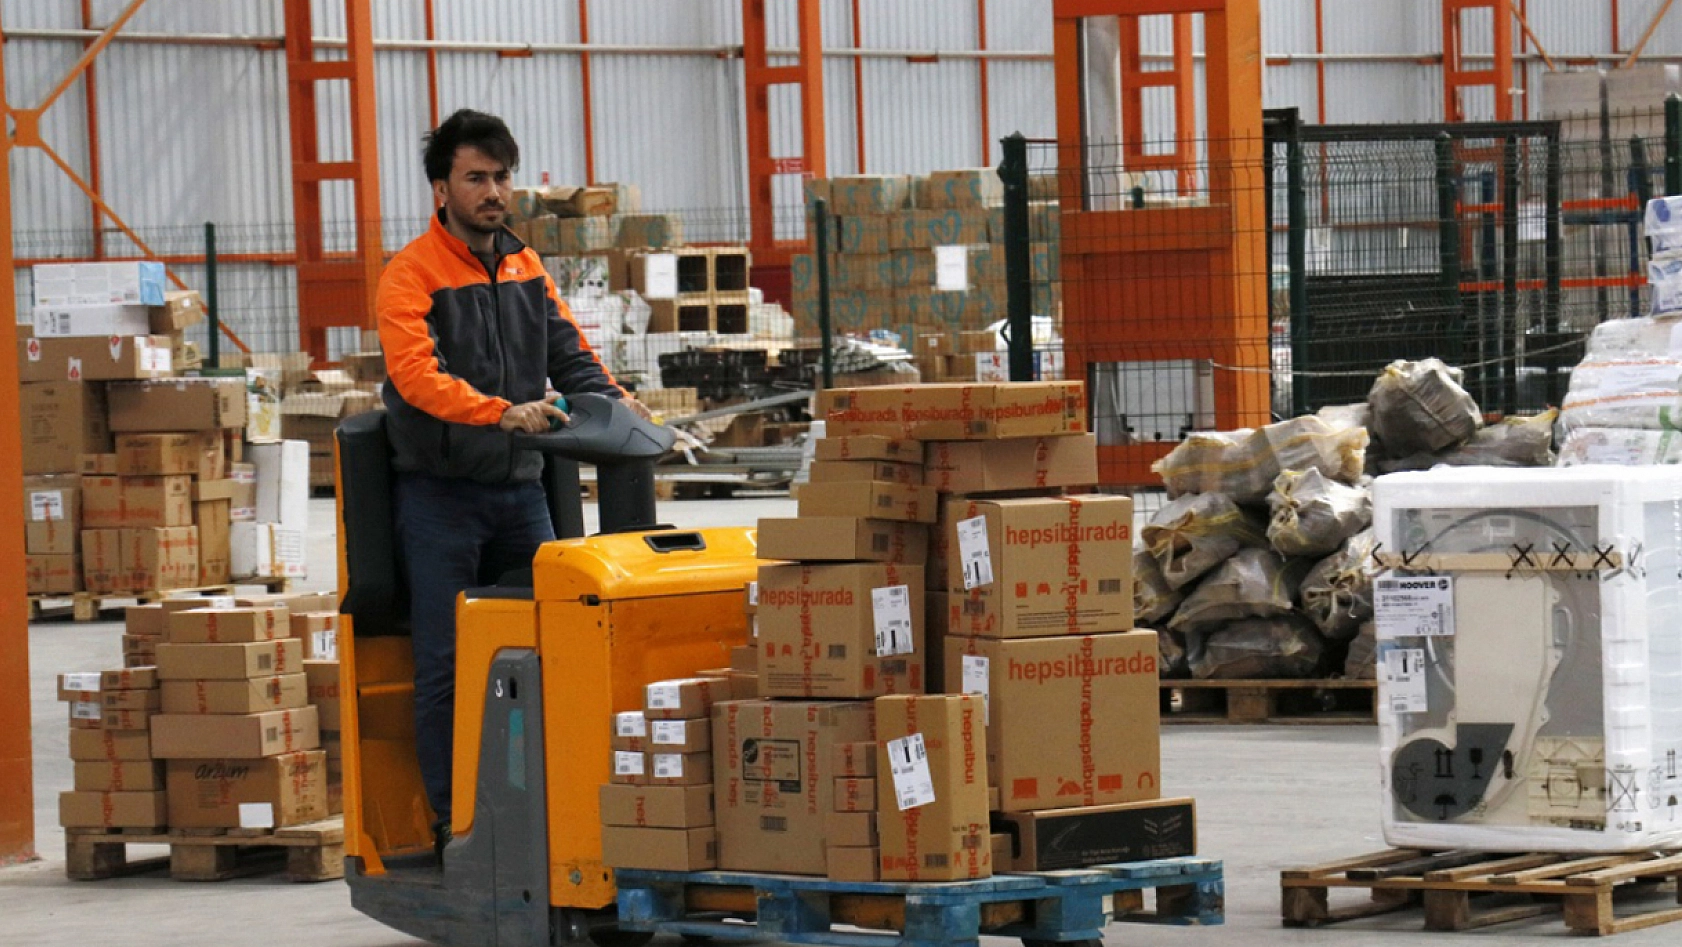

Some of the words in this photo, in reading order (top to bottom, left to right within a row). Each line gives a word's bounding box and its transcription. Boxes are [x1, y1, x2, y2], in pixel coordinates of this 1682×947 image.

[1006, 521, 1129, 548] hepsiburada
[1399, 580, 1436, 590] HOOVER
[759, 587, 853, 610] hepsiburada
[1009, 650, 1156, 684] hepsiburada
